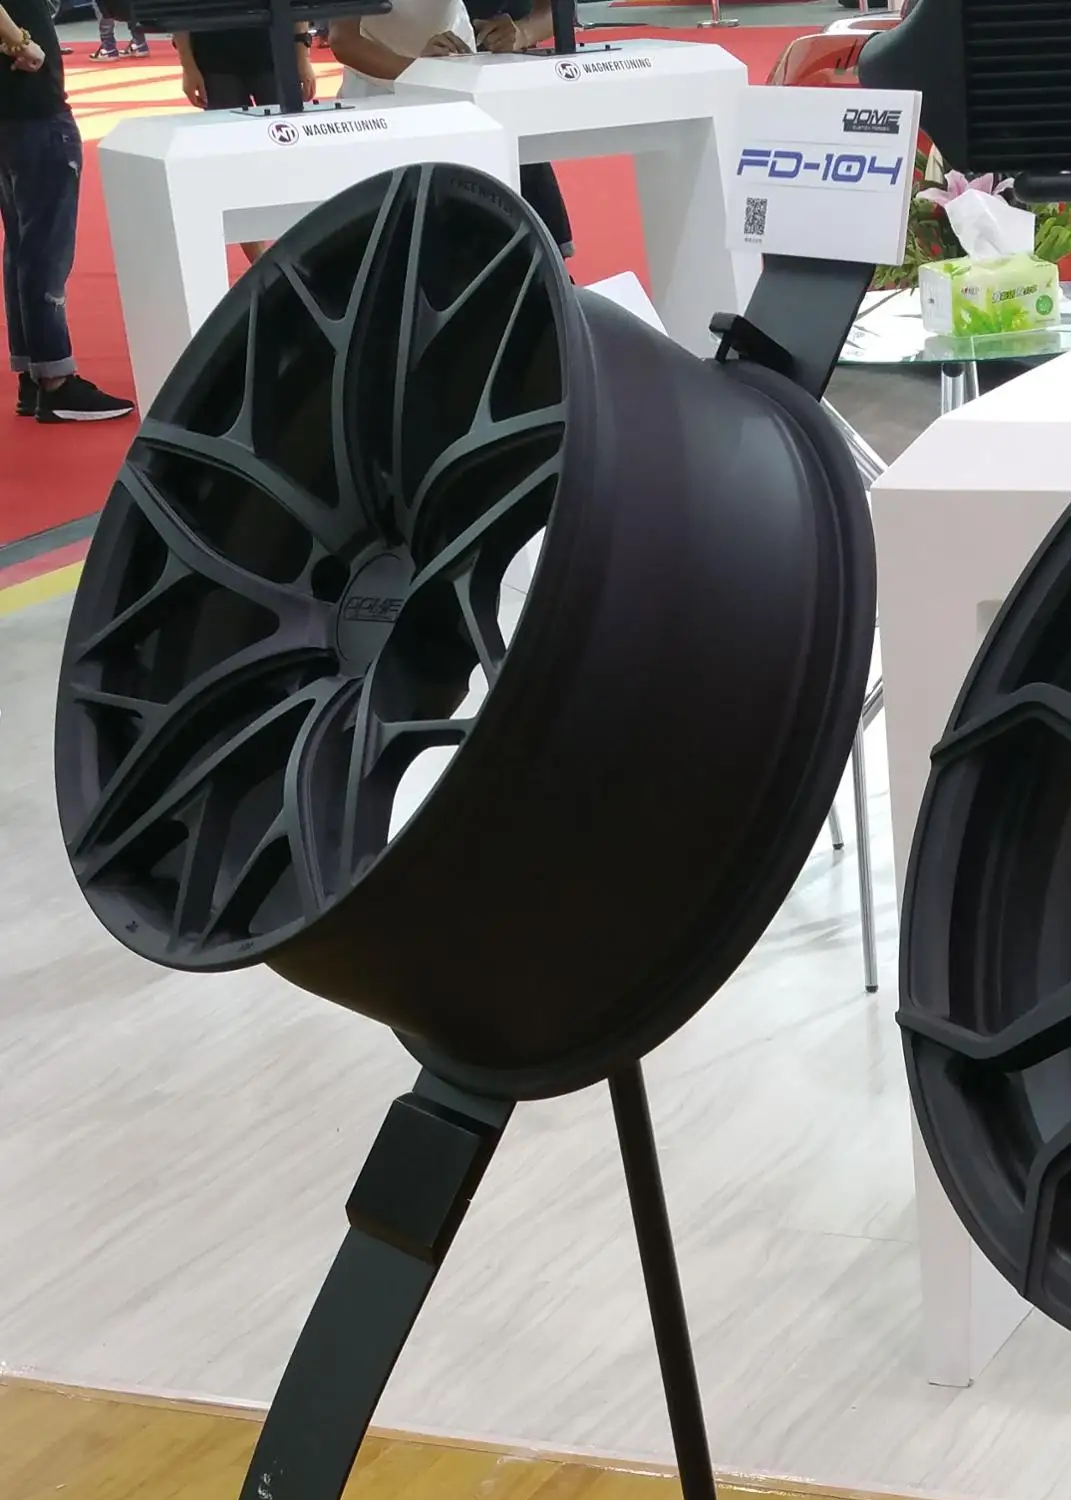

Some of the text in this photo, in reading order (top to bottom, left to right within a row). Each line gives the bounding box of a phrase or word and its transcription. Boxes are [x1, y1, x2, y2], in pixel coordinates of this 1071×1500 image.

[582, 58, 652, 74] WAGNERTUNING
[842, 109, 903, 125] DOME
[302, 118, 388, 136] WAGNERTUNING
[736, 149, 903, 185] FD-104
